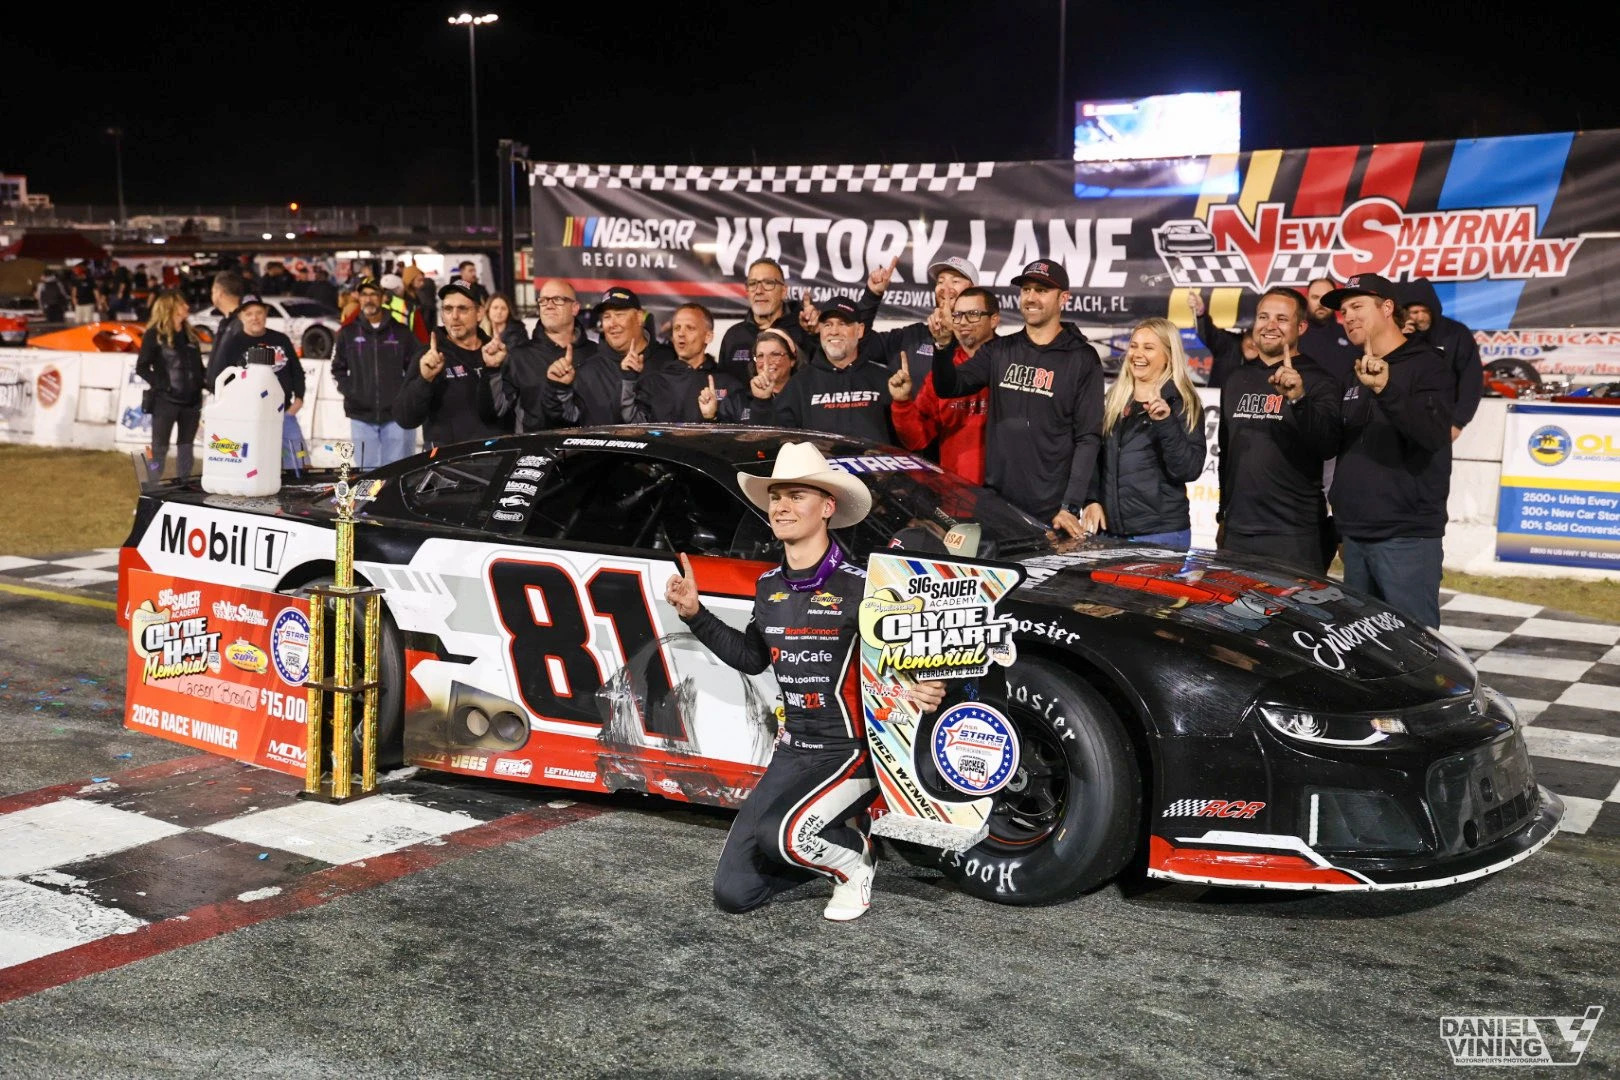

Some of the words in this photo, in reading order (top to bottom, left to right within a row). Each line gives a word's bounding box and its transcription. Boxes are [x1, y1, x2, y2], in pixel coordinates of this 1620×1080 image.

[592, 217, 697, 250] NASCAR
[715, 216, 949, 284] VICTORY
[967, 218, 1132, 288] LANE
[1211, 207, 1337, 288] NEW
[582, 252, 678, 269] REGIONAL
[1061, 295, 1107, 314] EACH,
[1111, 297, 1129, 312] FL
[1483, 346, 1540, 356] UTO
[811, 390, 880, 406] EARNEST
[209, 442, 241, 450] SUNOCO
[563, 438, 605, 446] CARSON
[606, 440, 648, 449] BROWN
[1523, 492, 1556, 503] 2500+
[1559, 494, 1585, 505] Units
[1588, 496, 1618, 508] Every
[1522, 506, 1549, 516] 300+
[1551, 507, 1575, 518] New
[1576, 509, 1596, 519] Car
[1545, 521, 1568, 532] Sold
[160, 514, 248, 566] Mobil
[265, 533, 275, 568] 1
[908, 577, 931, 594] SIG
[931, 580, 977, 599] SAUER
[158, 588, 173, 606] SIG
[171, 590, 201, 610] SAUER
[811, 595, 842, 603] SUNOCO
[929, 597, 976, 608] ACADEMY
[785, 627, 839, 636] BrandConnect
[882, 607, 984, 641] CLYDE
[1004, 612, 1081, 645] osier
[146, 617, 207, 651] CLYDE
[285, 630, 309, 641] STARS
[912, 624, 1007, 656] HART
[164, 632, 221, 665] HART
[488, 558, 688, 741] 81
[780, 650, 833, 665] PayCafe
[878, 641, 986, 675] Memorial
[143, 651, 208, 683] Memorial
[918, 667, 953, 679] FEBRUARY
[795, 676, 830, 684] LOGISTICS
[260, 688, 307, 723] $15,00
[1006, 681, 1076, 742] osier
[132, 704, 159, 727] 2026
[161, 711, 189, 736] RACE
[192, 719, 238, 749] WINNER
[960, 730, 1005, 744] STARS
[451, 754, 488, 771] JEGS
[499, 761, 532, 774] RPM
[960, 759, 986, 770] SUCKER
[544, 766, 597, 779] LEFTHANDER
[960, 766, 985, 777] PUNCH
[1199, 800, 1266, 819] RCR
[797, 814, 820, 842] CAPTAL
